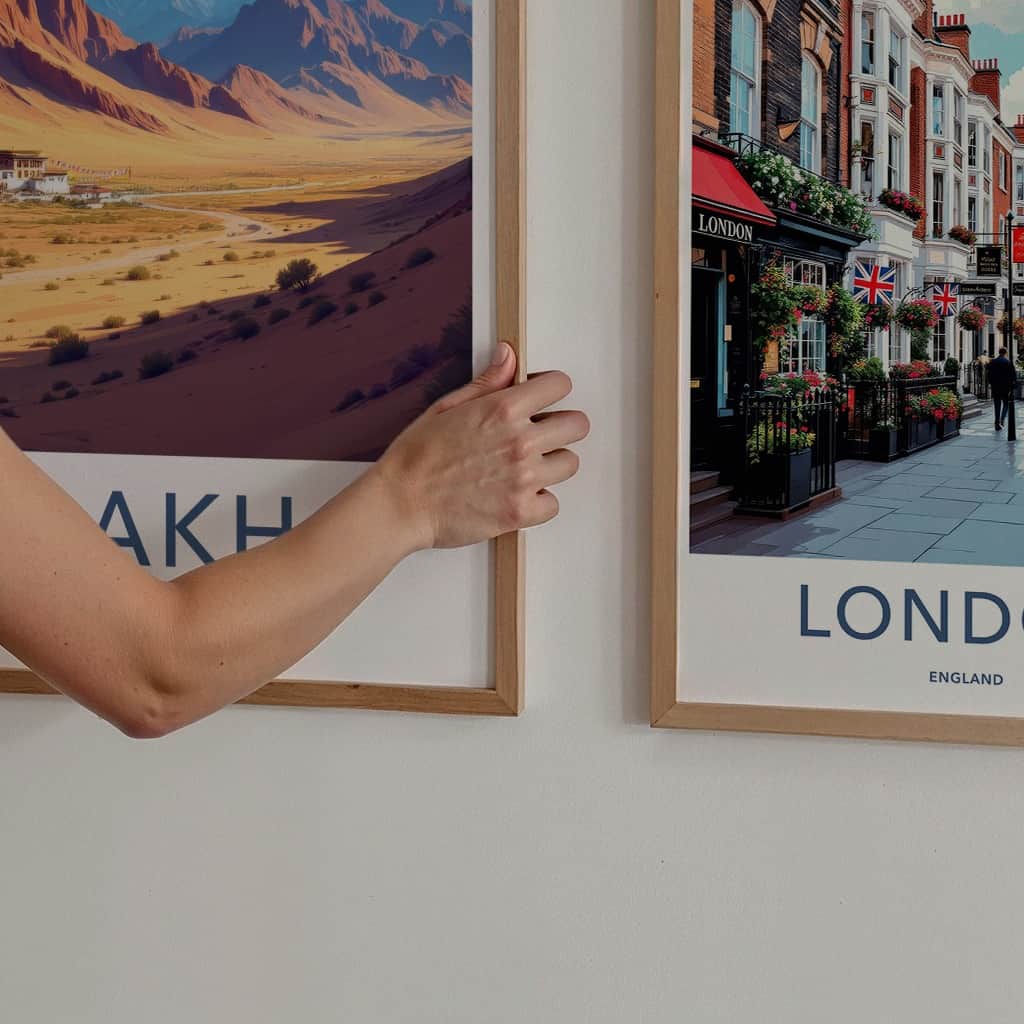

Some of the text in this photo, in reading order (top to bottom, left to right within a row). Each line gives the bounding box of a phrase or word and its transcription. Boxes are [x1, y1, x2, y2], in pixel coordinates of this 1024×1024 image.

[698, 213, 753, 242] LONDON
[800, 584, 1024, 645] LOND
[929, 671, 1004, 686] ENGLAND
